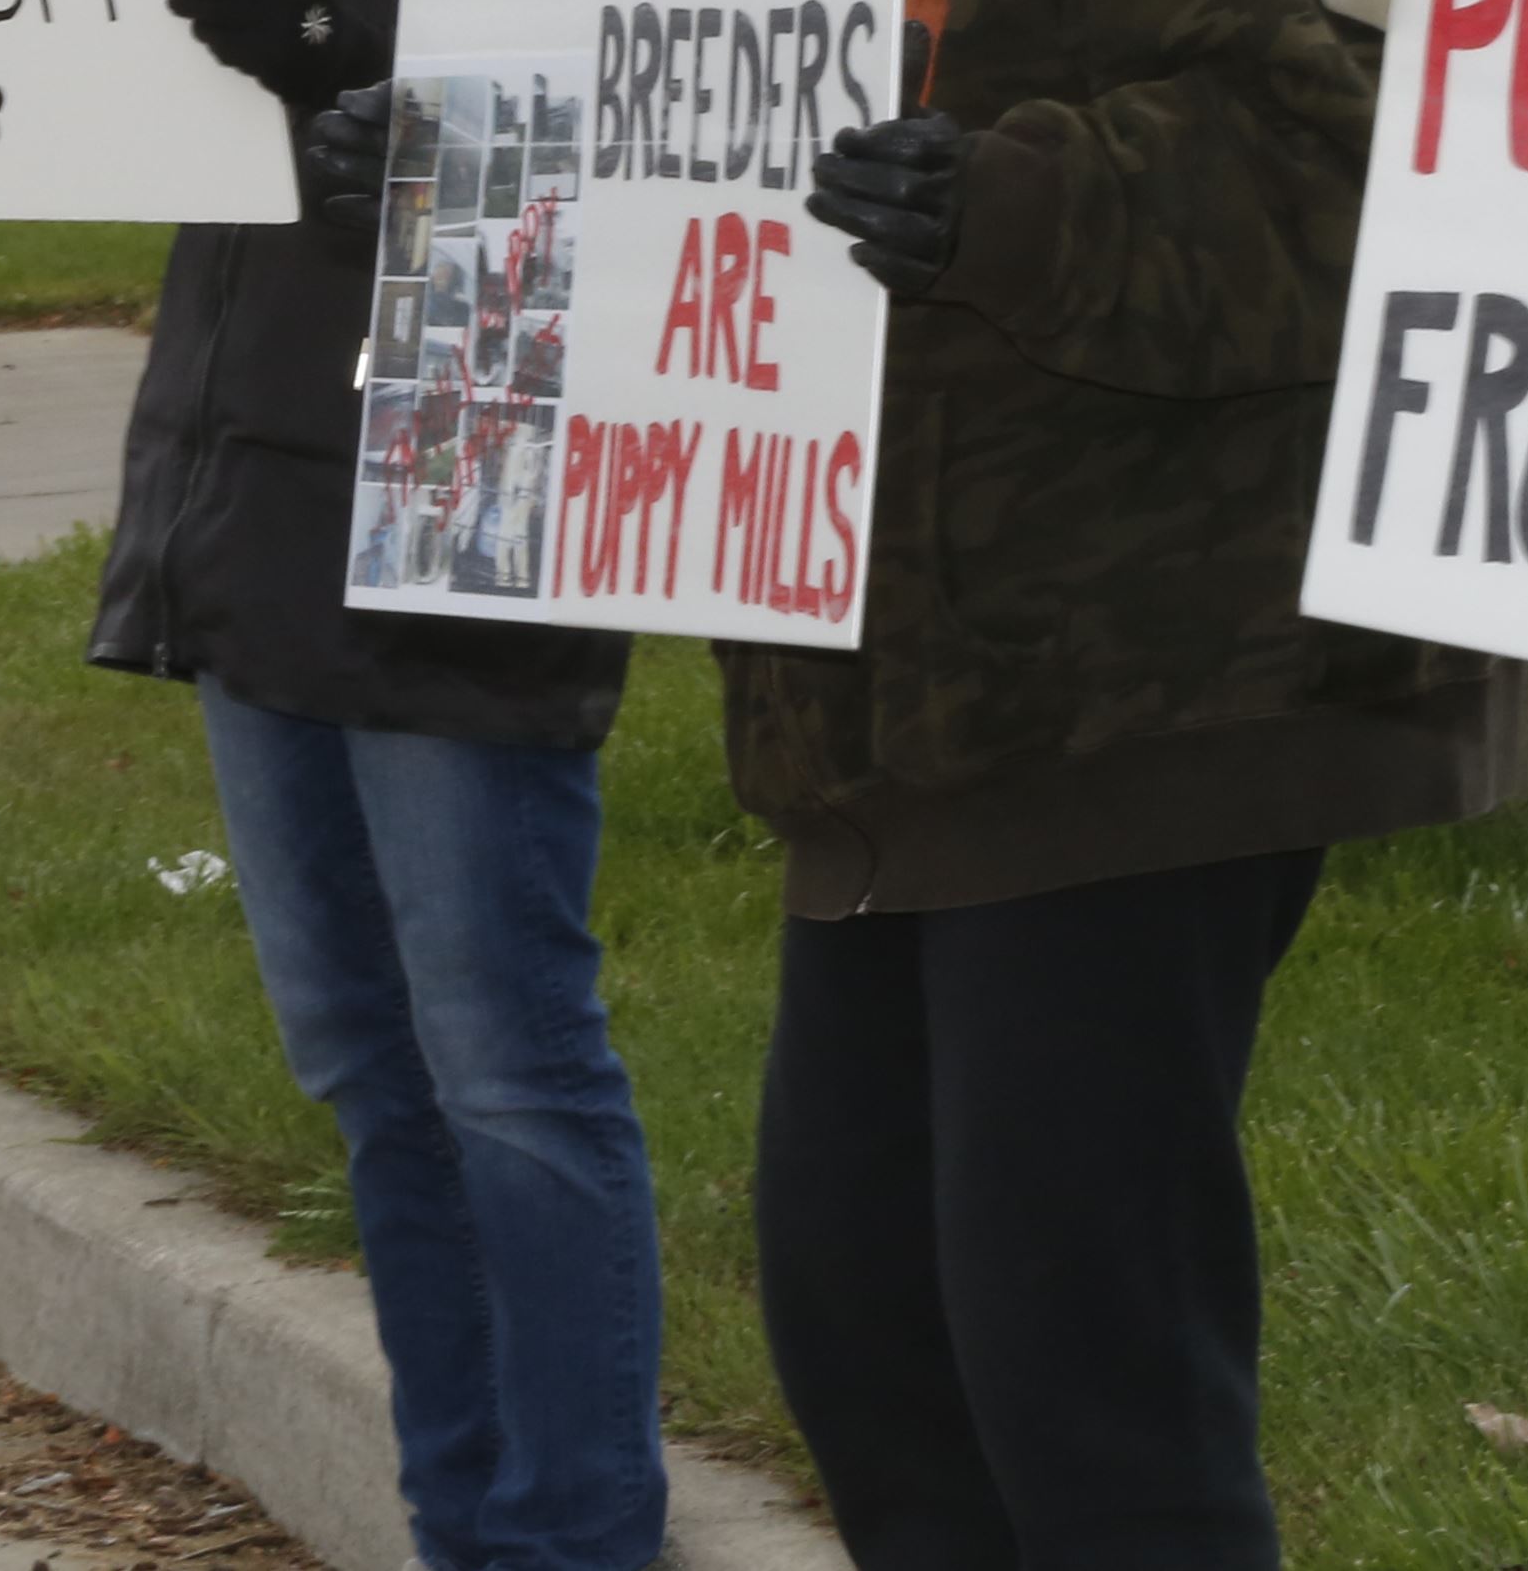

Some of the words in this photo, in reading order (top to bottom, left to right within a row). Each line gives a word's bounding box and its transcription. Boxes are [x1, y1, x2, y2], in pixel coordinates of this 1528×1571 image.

[594, 0, 875, 190] BREEDERS
[655, 212, 790, 391] ARE
[551, 414, 701, 600] PUPPY
[712, 427, 861, 624] MILLS
